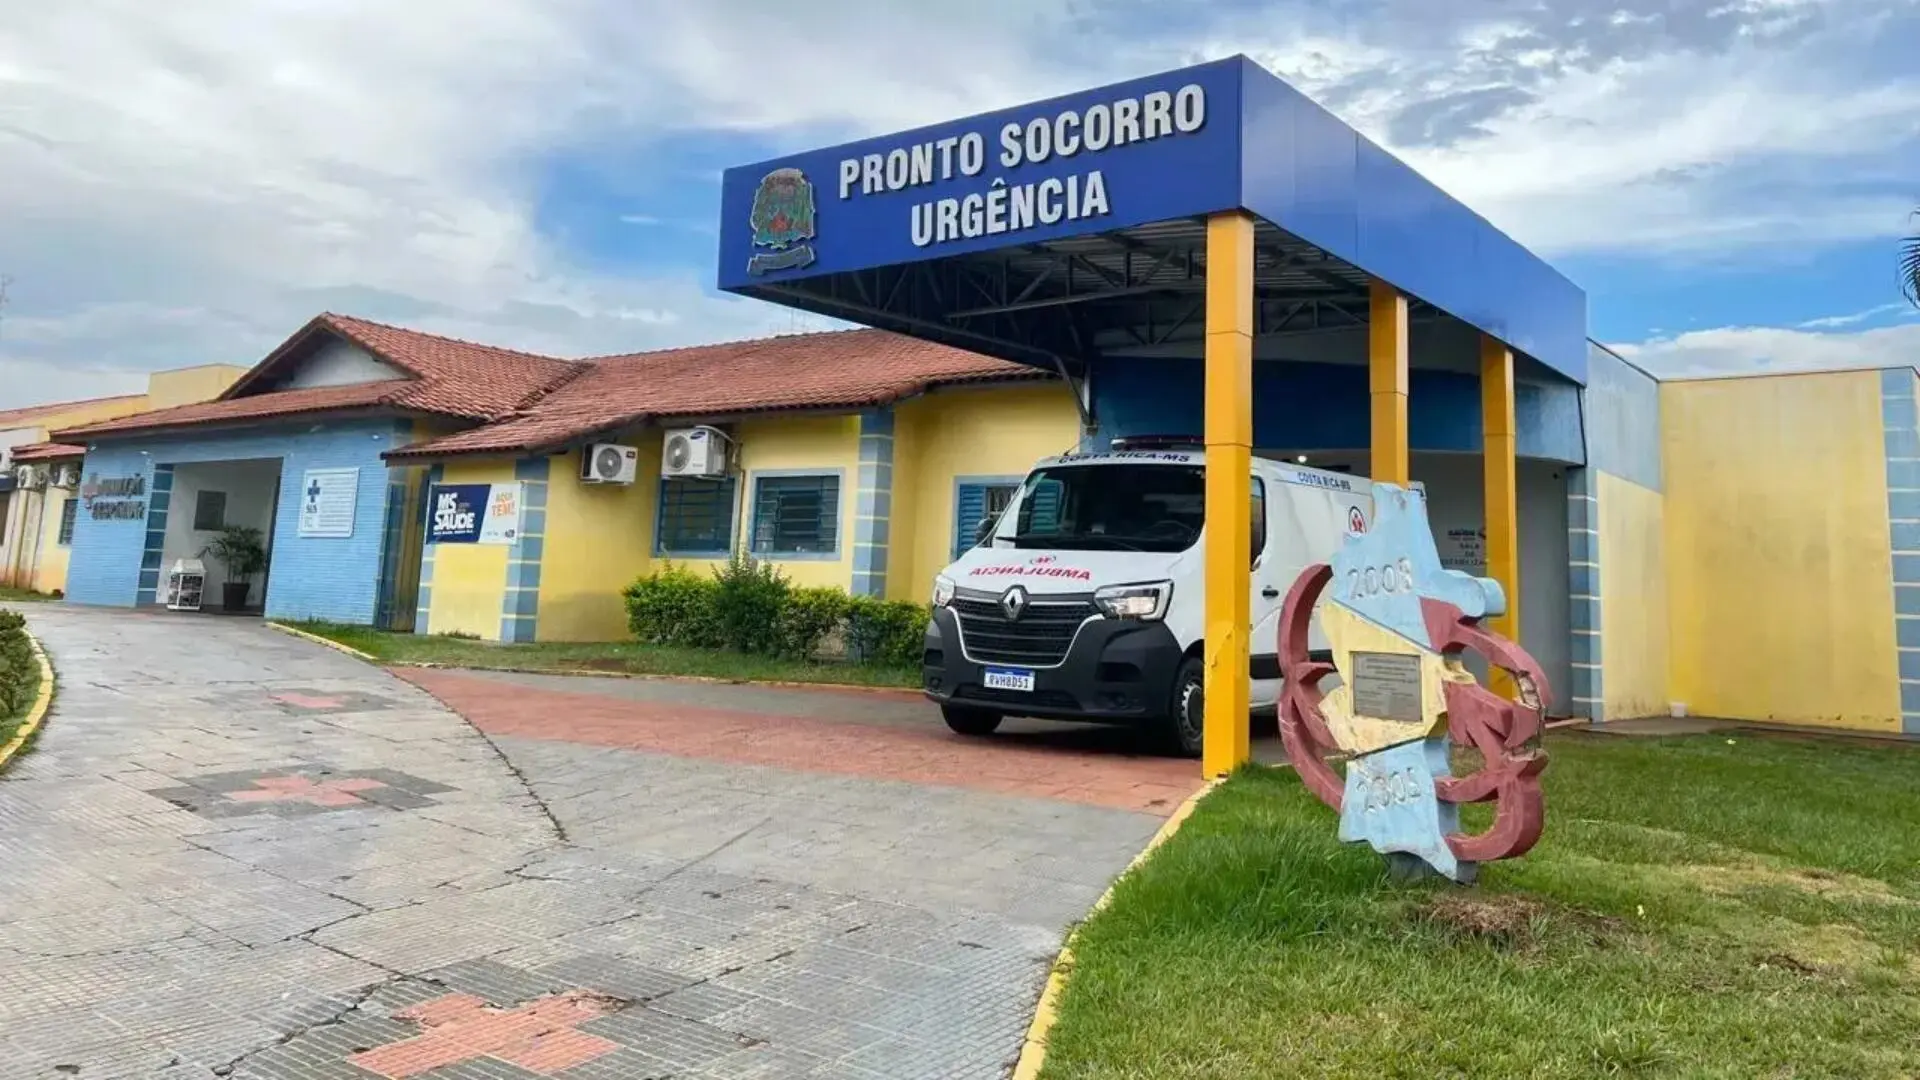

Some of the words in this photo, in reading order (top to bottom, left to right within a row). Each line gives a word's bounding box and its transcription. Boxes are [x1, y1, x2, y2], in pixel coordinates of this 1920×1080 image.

[839, 132, 984, 200] PRONTO
[1000, 83, 1206, 169] SOCORRO
[911, 170, 1110, 247] URGÊNCIA
[1059, 452, 1110, 464] COSTA
[1116, 451, 1190, 462] RICA-MS
[437, 492, 458, 512] MS
